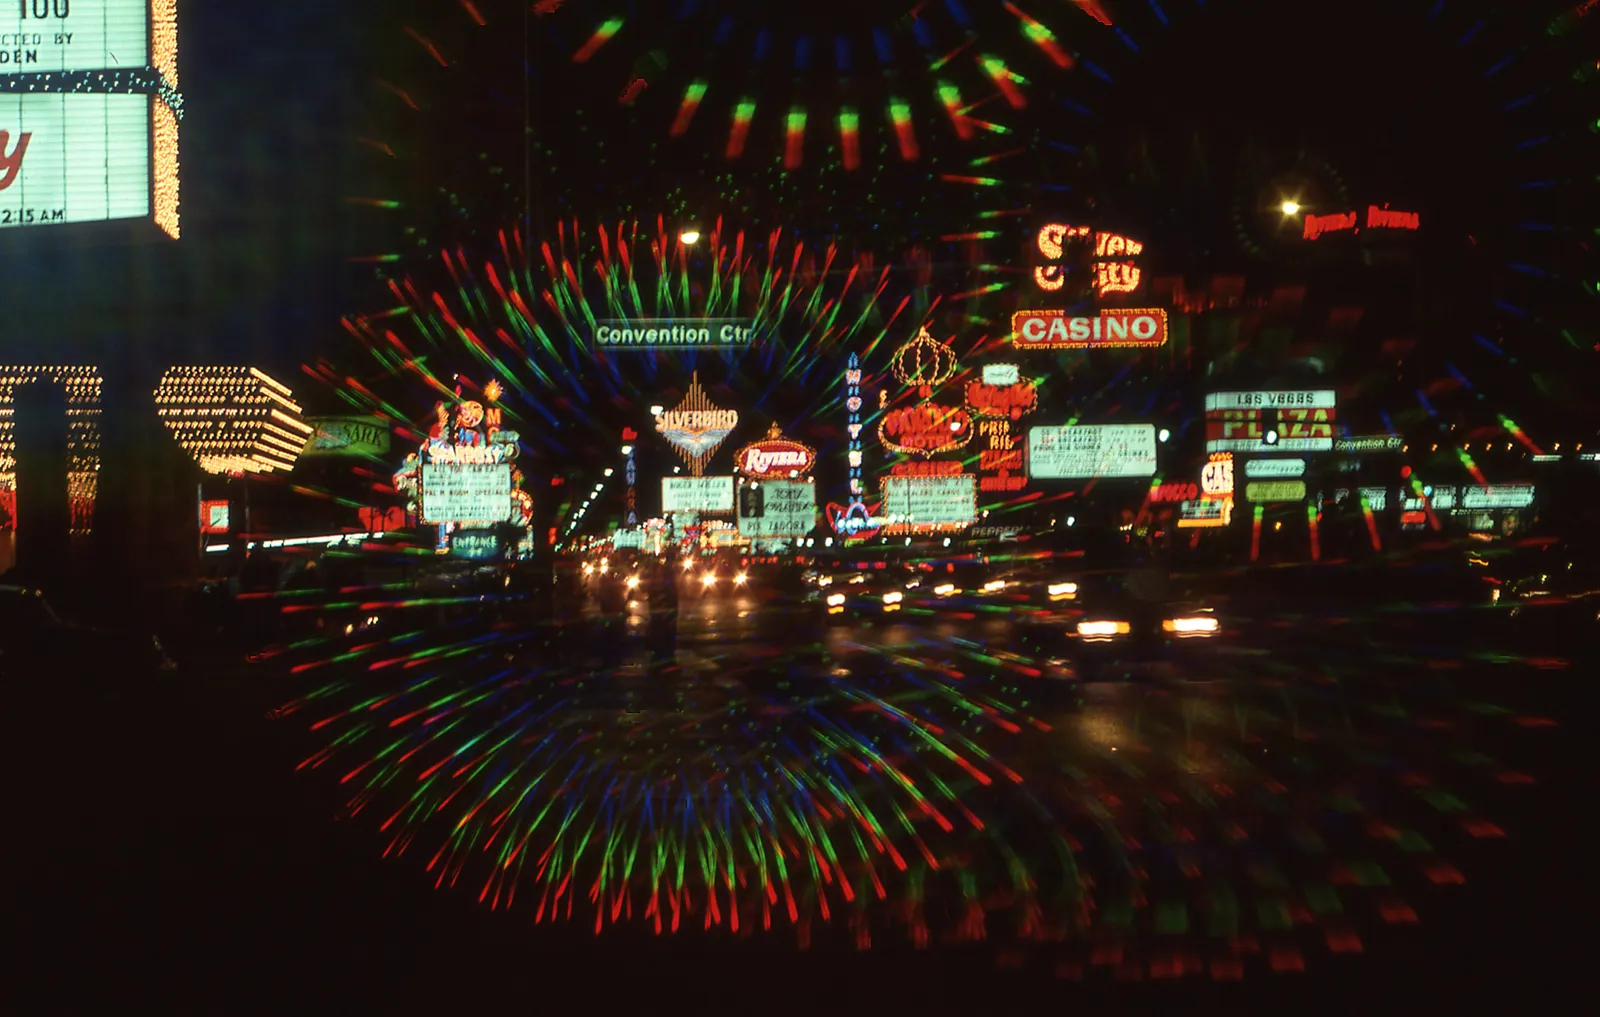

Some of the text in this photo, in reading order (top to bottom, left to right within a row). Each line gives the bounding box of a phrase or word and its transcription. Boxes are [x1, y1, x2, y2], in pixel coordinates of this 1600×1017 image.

[54, 33, 73, 45] BY
[40, 209, 64, 221] AM
[596, 324, 752, 344] Convention Ctr
[1021, 315, 1158, 342] CASINO
[1237, 392, 1315, 405] LAS VEGAS
[654, 409, 739, 433] SILVERBIRD
[1223, 408, 1333, 439] PLAZA
[342, 421, 381, 448] SARK
[845, 368, 863, 495] MOTEL
[1335, 438, 1385, 450] Convention
[452, 535, 498, 549] ENTRANCE
